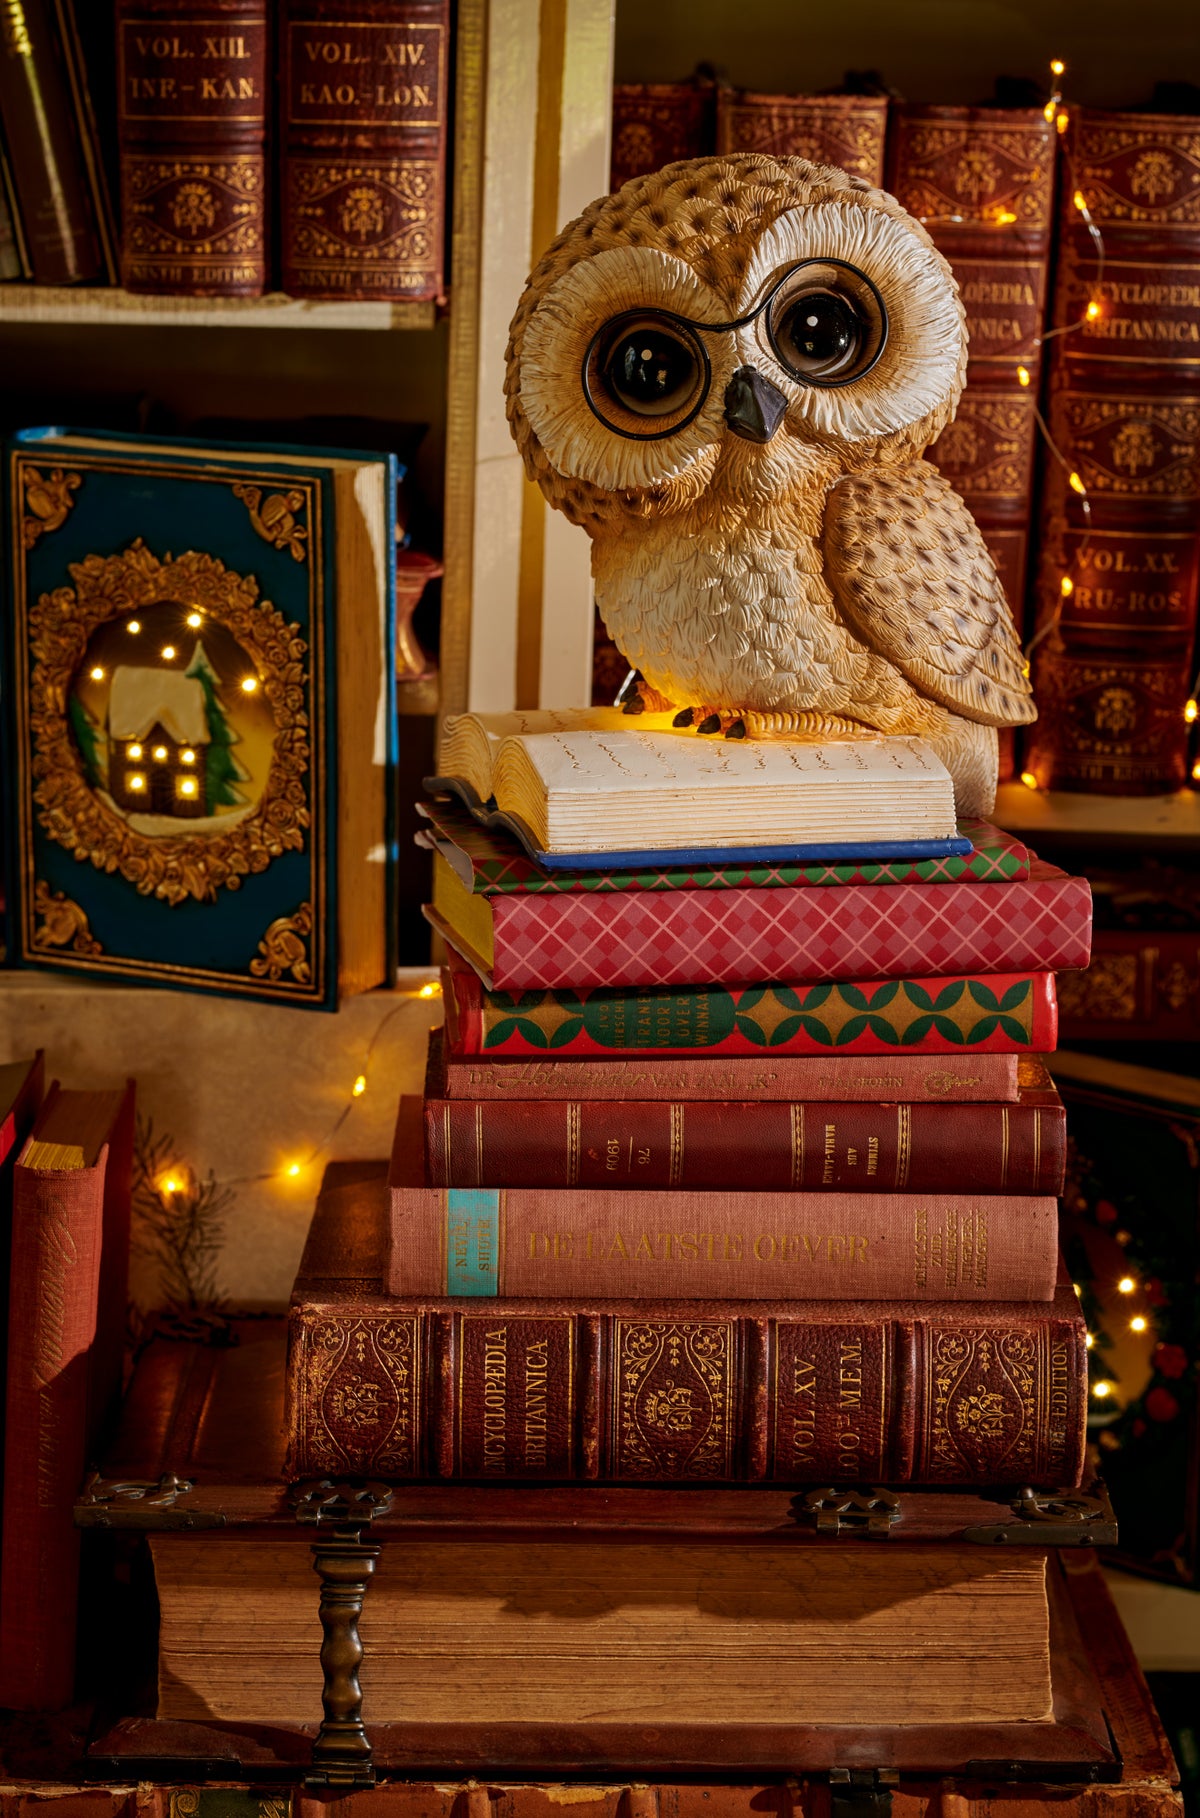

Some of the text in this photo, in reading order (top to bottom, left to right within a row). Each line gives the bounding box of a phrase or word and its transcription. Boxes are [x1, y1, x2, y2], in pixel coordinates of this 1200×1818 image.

[136, 37, 251, 58] VOL. XIII.
[305, 42, 427, 66] VOL. XIV.
[1075, 548, 1140, 573] VOL.
[469, 1070, 494, 1085] DE
[638, 1147, 651, 1166] 76
[847, 1146, 857, 1167] AUS
[528, 1232, 871, 1263] DE LAATSTE OEVER
[1051, 1341, 1068, 1417] EDITION
[525, 1339, 548, 1467] BRITANNICA
[792, 1353, 817, 1467] VOL. XV.
